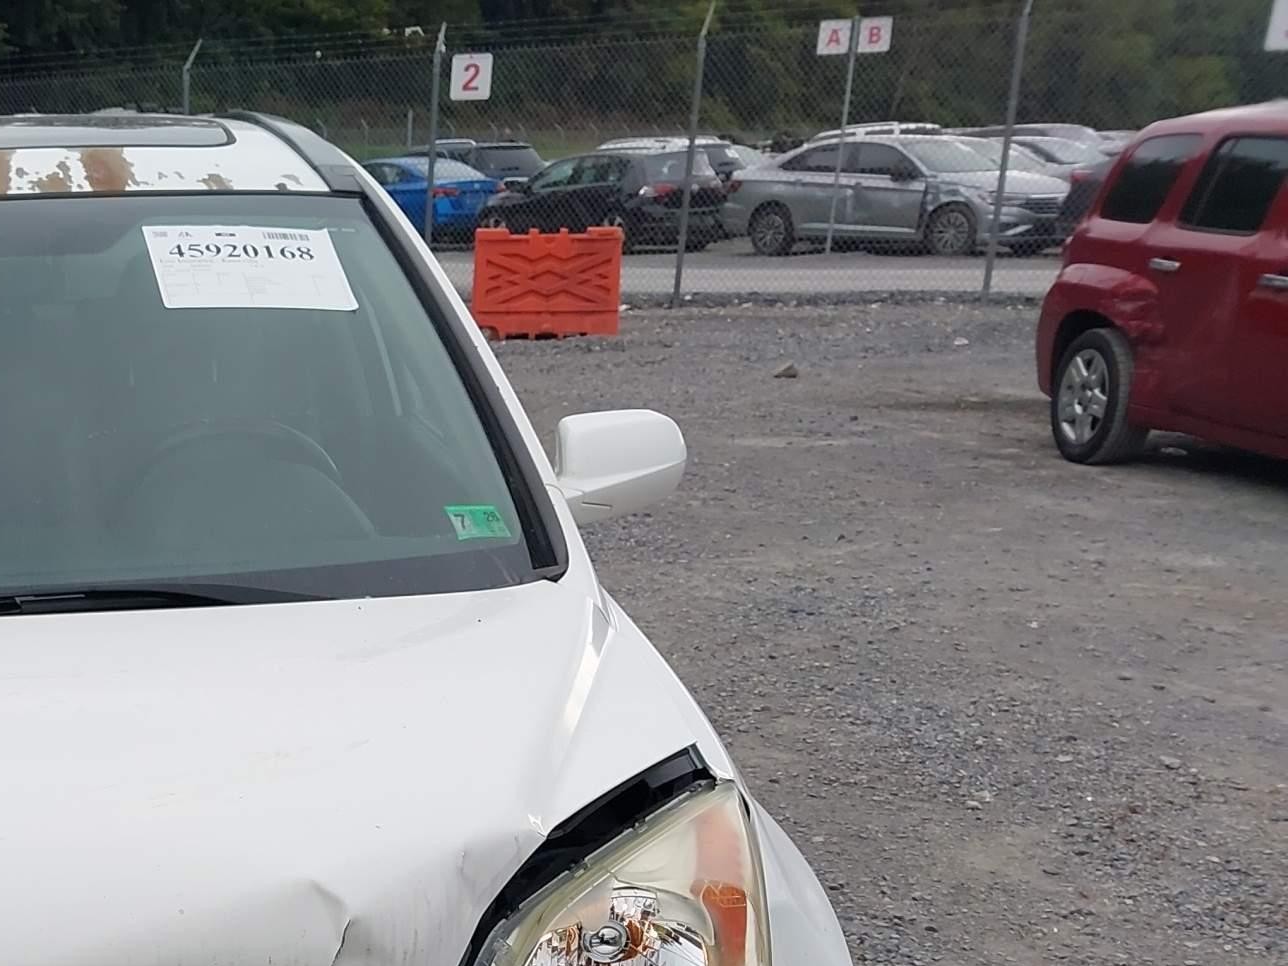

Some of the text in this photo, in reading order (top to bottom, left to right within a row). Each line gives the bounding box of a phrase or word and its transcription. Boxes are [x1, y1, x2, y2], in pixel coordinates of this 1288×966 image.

[826, 28, 841, 47] A
[868, 26, 881, 45] B
[462, 63, 480, 91] 2
[168, 243, 315, 261] 45920168
[453, 513, 466, 530] 7
